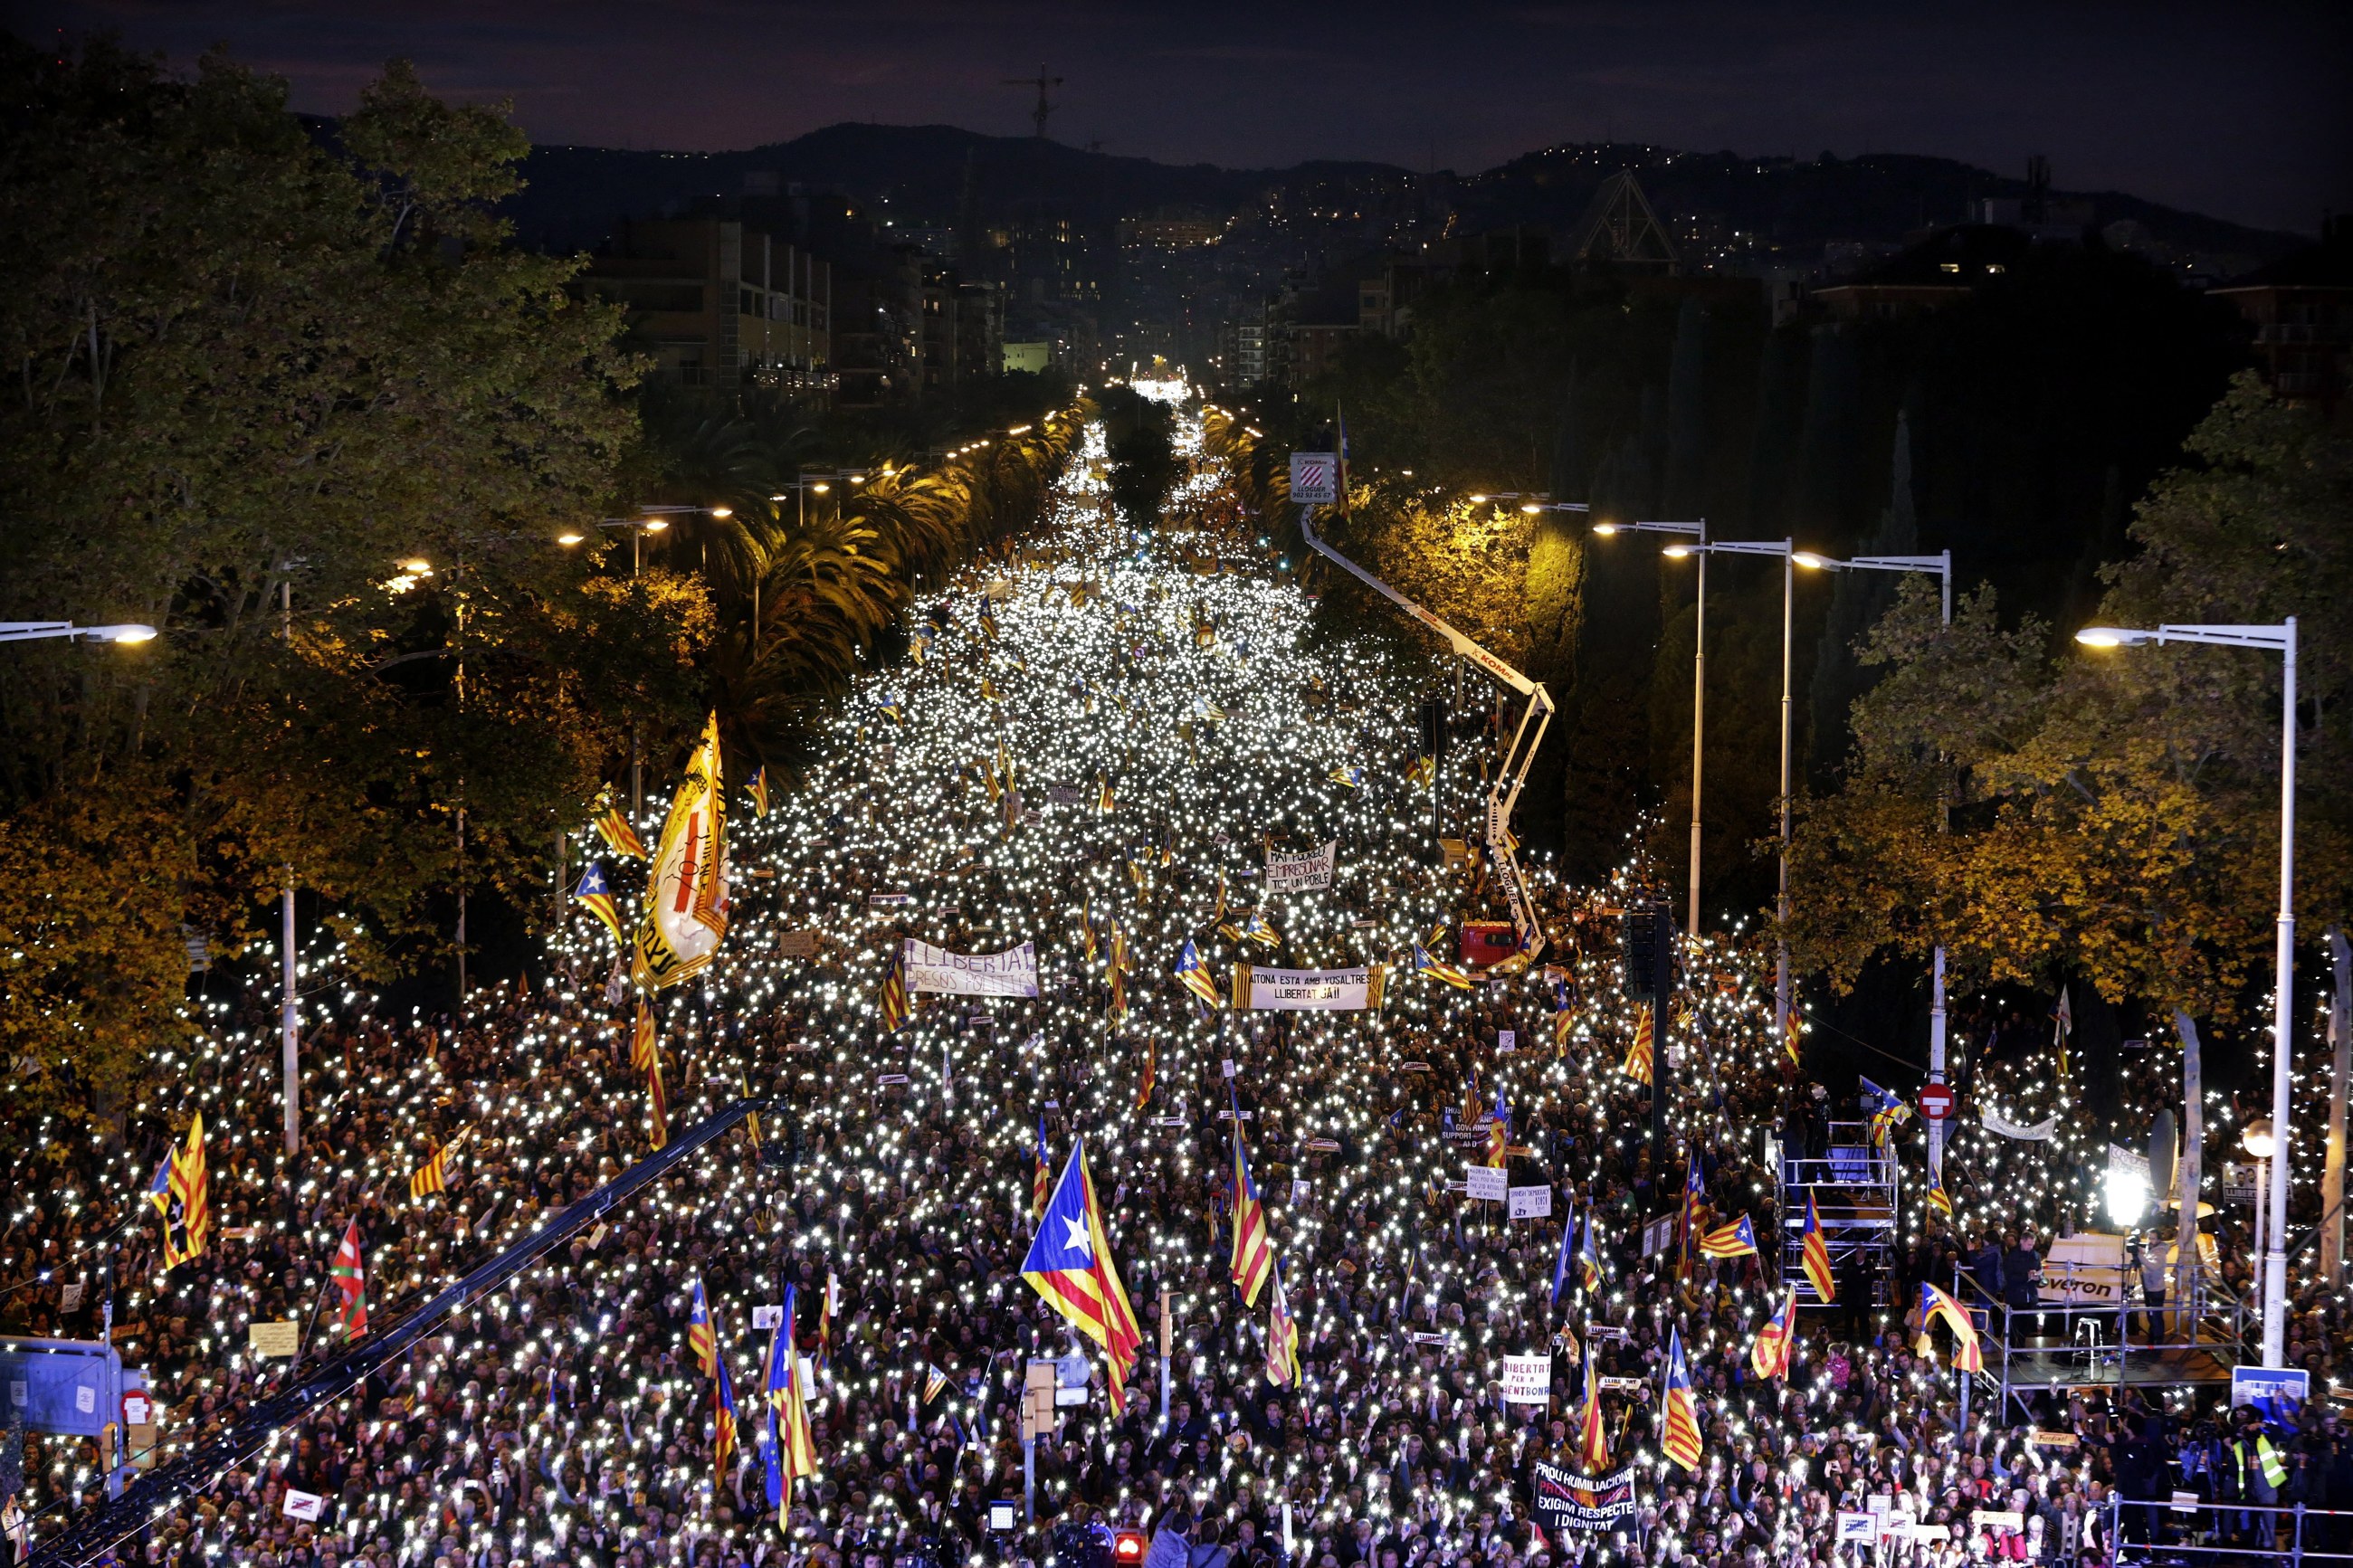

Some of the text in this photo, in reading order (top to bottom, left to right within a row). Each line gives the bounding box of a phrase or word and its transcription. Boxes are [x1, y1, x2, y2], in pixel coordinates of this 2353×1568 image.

[1267, 856, 1330, 878] EMPRESONAR
[1291, 878, 1303, 888] UN
[1305, 872, 1329, 886] POBLE
[1499, 861, 1519, 905] LLOGUER
[910, 941, 1033, 973] LLIBERTAT
[908, 970, 957, 991] PRESOS
[1280, 975, 1300, 984] ESTA
[1304, 976, 1321, 984] AMB
[1275, 988, 1317, 999] LLIBERTAT
[1442, 1131, 1472, 1139] SUPPORT
[1536, 1462, 1634, 1492] PROU HUMILIACIONS
[1539, 1496, 1634, 1519] EXIGIM RESPECTE
[1555, 1514, 1612, 1531] I DIGNITAT
